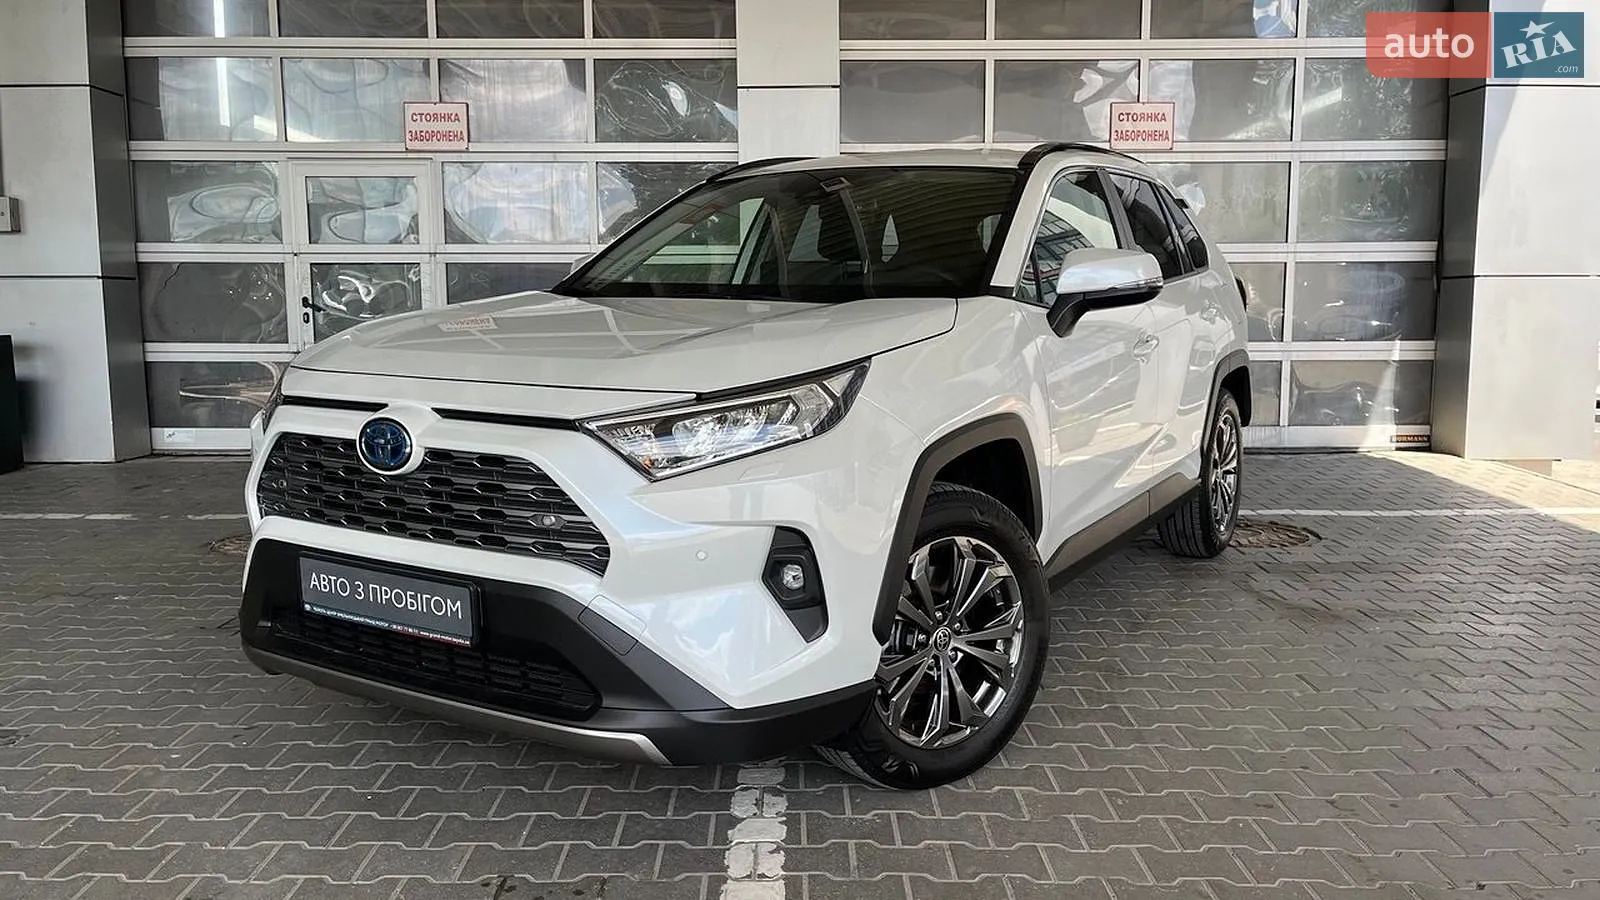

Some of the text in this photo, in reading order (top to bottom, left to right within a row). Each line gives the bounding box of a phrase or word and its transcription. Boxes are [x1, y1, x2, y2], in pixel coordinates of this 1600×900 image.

[411, 112, 461, 123] СТОЯНКА
[1118, 112, 1167, 122] СТОЯНКА
[408, 130, 465, 142] ЗАБОРОНЕНА
[1114, 129, 1170, 142] ЗАБОРОНЕНА
[310, 572, 350, 597] АВТО
[369, 584, 462, 619] ПРОБІГОМ
